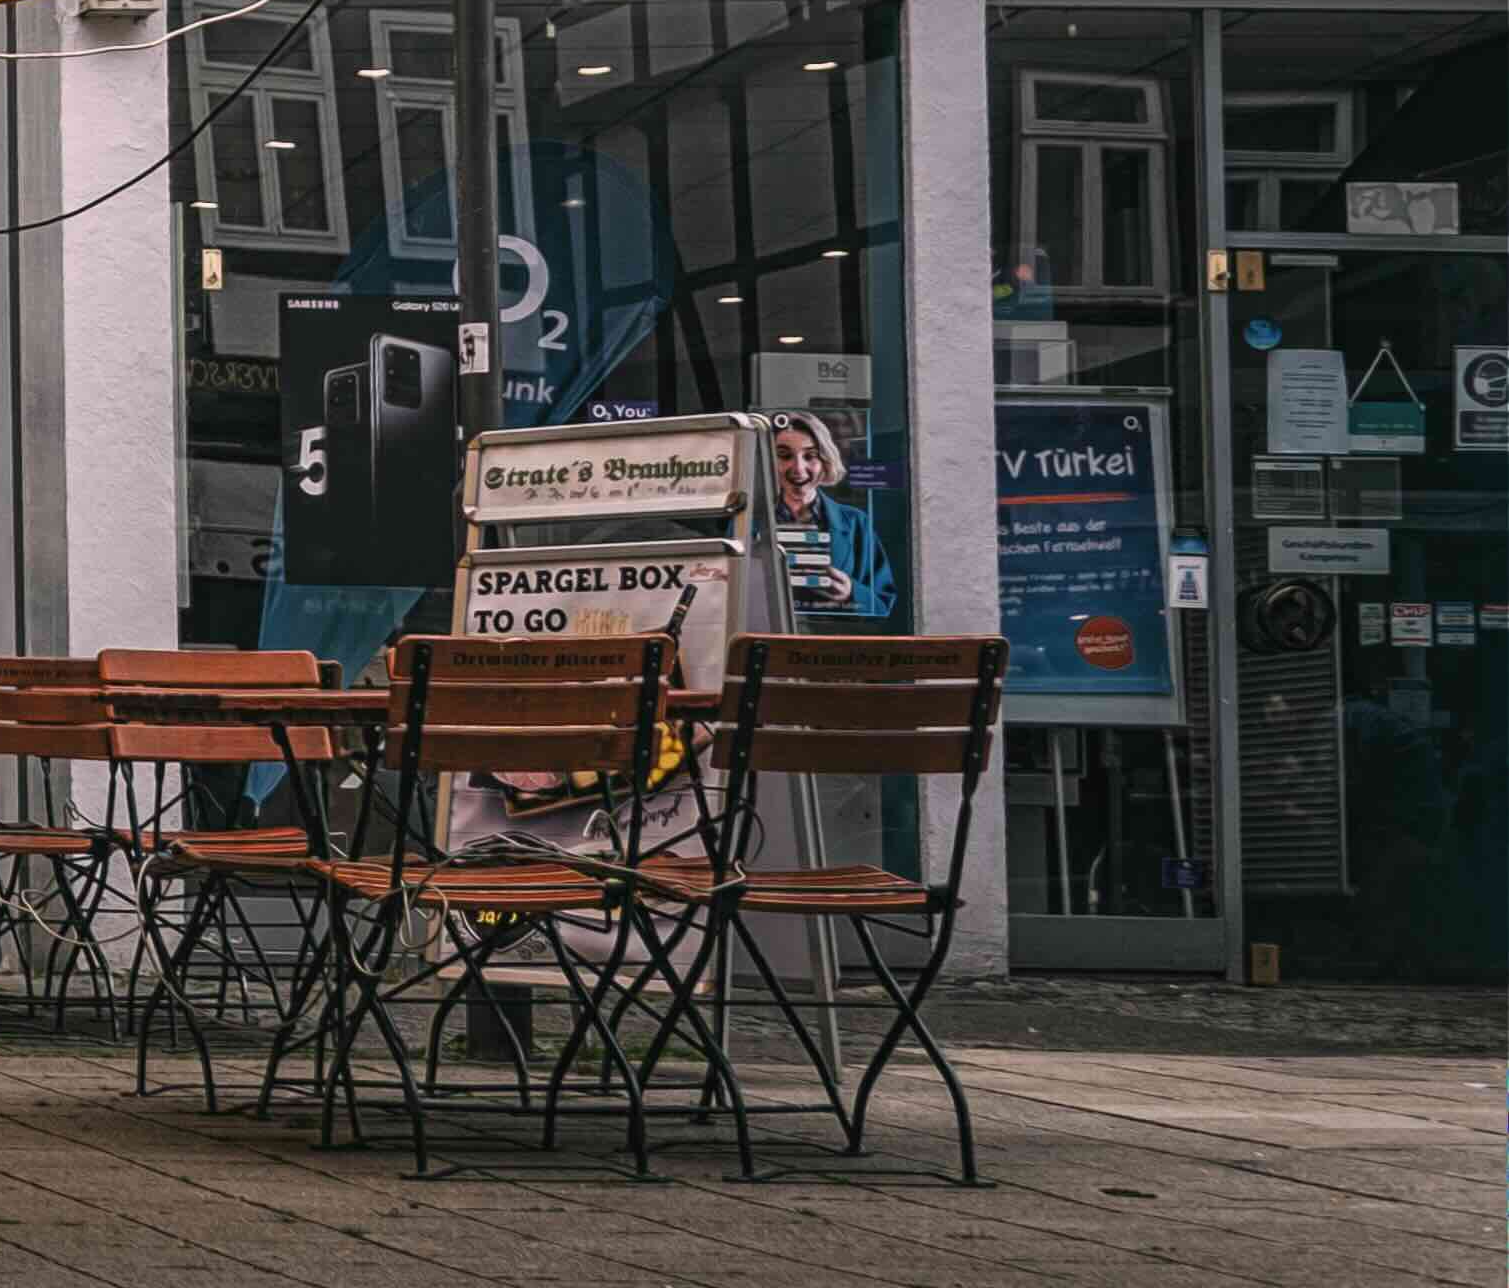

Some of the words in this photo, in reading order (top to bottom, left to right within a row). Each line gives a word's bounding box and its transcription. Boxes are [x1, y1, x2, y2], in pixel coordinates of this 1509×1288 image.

[287, 299, 339, 309] SAMSUNG
[392, 301, 430, 312] Galaxy
[604, 454, 730, 486] Brauhaus
[1034, 445, 1135, 478] Türkei
[477, 567, 609, 595] SPARGEL
[617, 564, 684, 591] BOX
[473, 608, 514, 634] TO
[524, 608, 567, 633] GO
